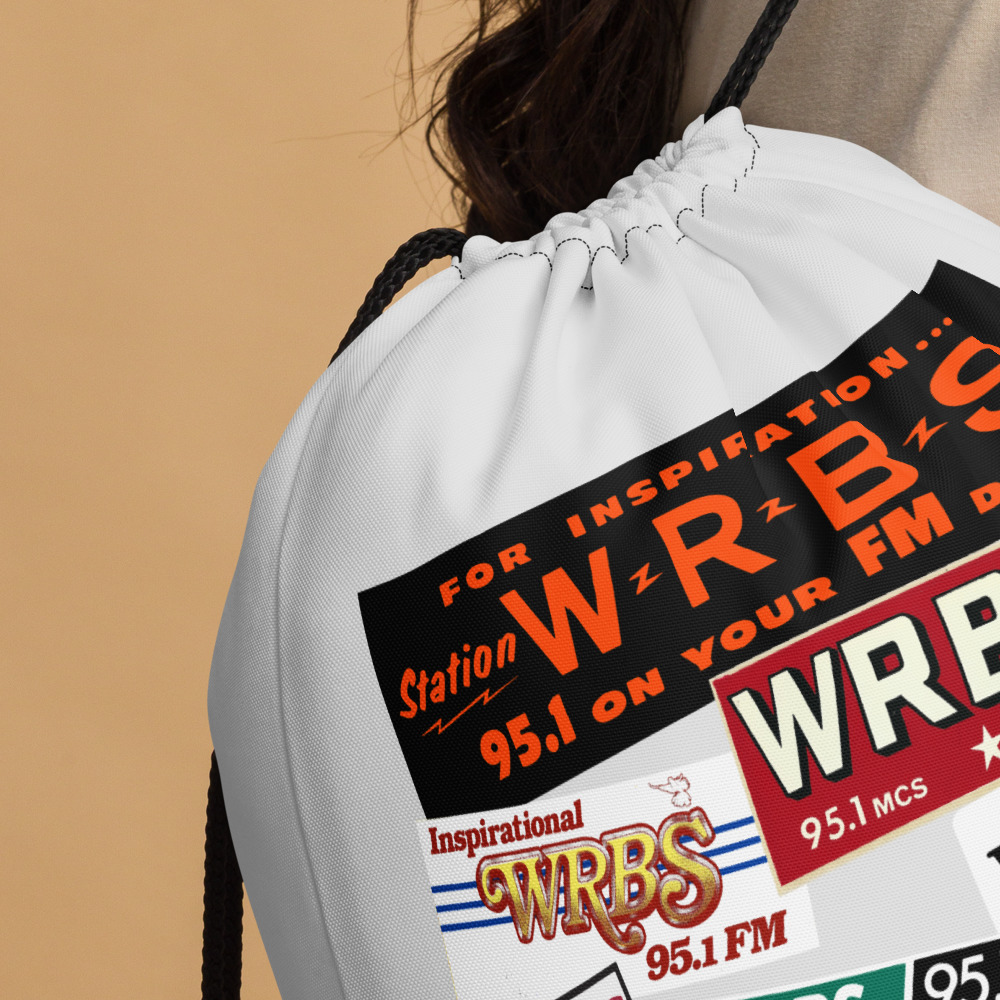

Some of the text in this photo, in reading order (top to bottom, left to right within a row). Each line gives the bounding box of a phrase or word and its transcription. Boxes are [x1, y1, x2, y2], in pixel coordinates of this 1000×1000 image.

[439, 543, 532, 606] FOR
[481, 694, 577, 781] 95.1
[592, 668, 665, 722] ON
[681, 577, 838, 671] YOUR
[847, 492, 954, 577] FM
[400, 632, 516, 719] Station
[428, 800, 584, 857] Inspirational
[800, 777, 928, 850] 95.1 MCS
[476, 806, 723, 955] WRBS
[646, 910, 788, 980] 95.1 FM
